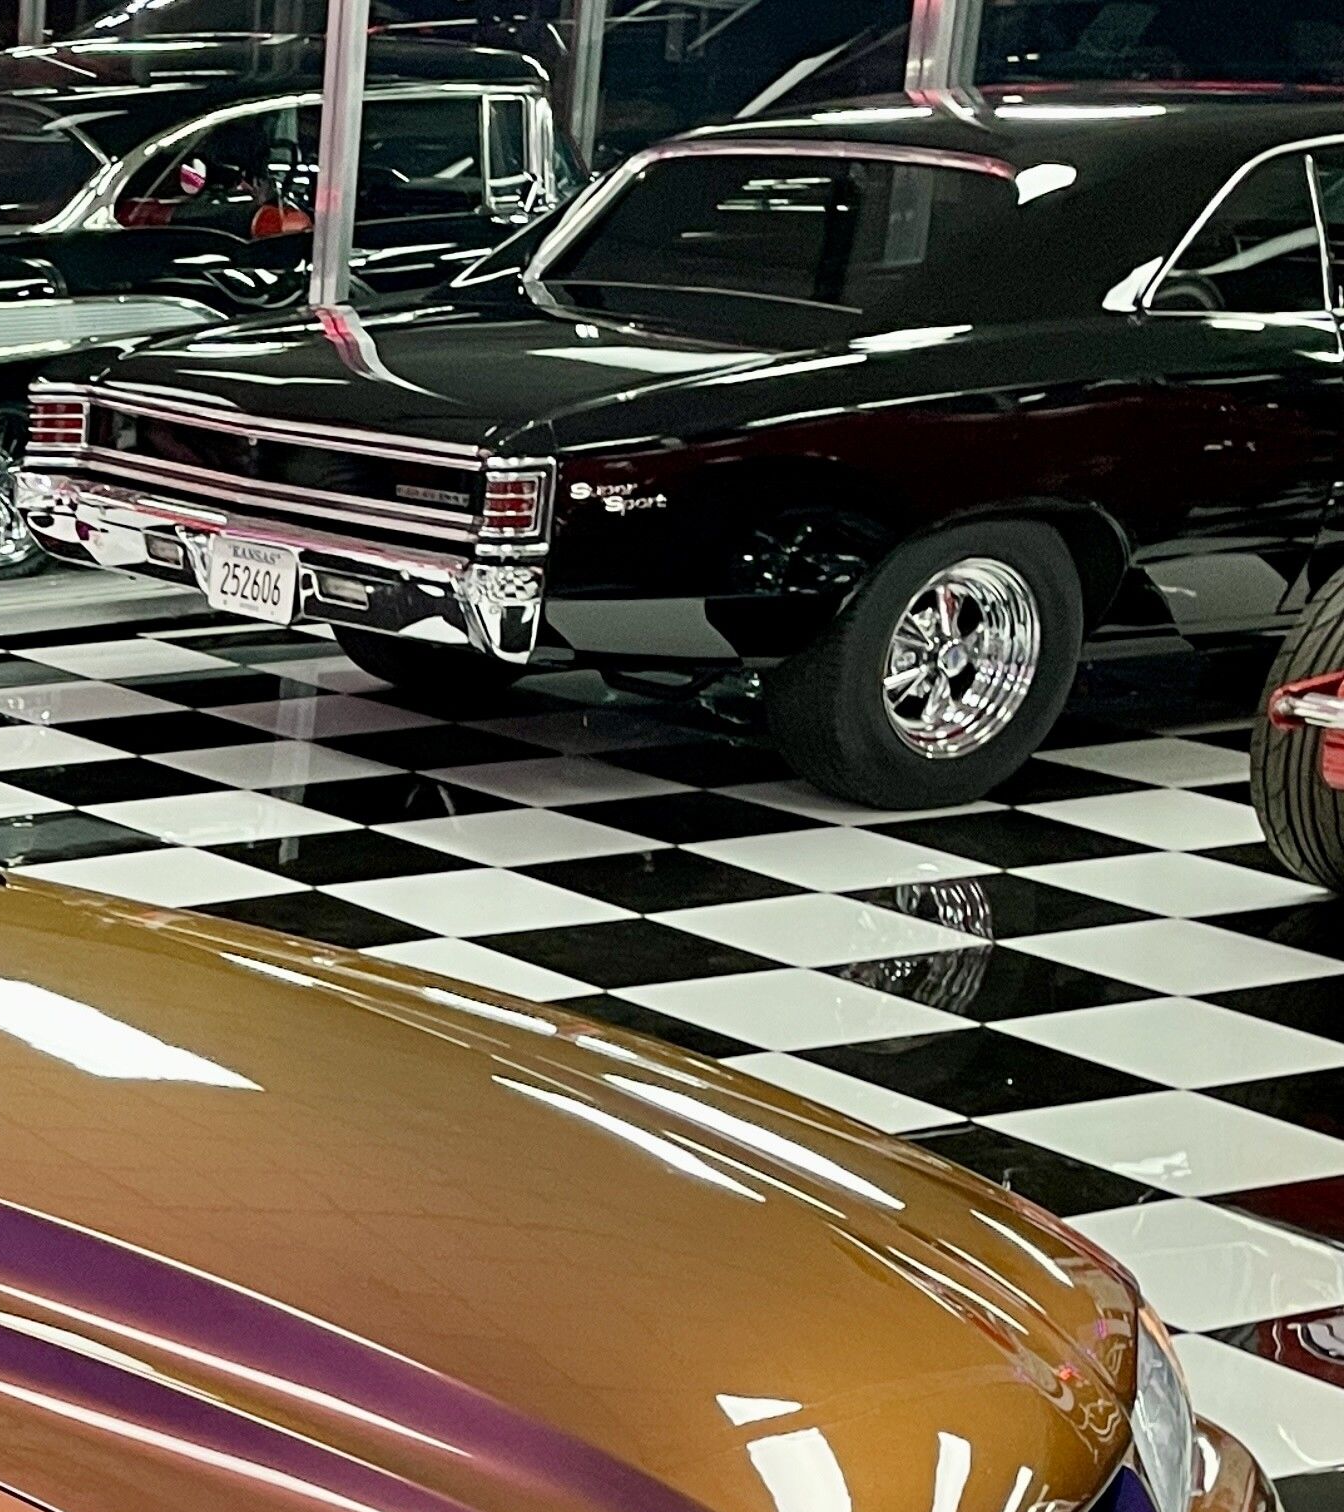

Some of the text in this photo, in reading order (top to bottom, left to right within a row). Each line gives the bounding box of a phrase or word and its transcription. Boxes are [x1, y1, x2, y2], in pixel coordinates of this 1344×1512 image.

[570, 482, 638, 500] Super
[602, 494, 667, 517] Sport
[232, 545, 276, 566] KANSAS
[219, 561, 281, 606] 252606
